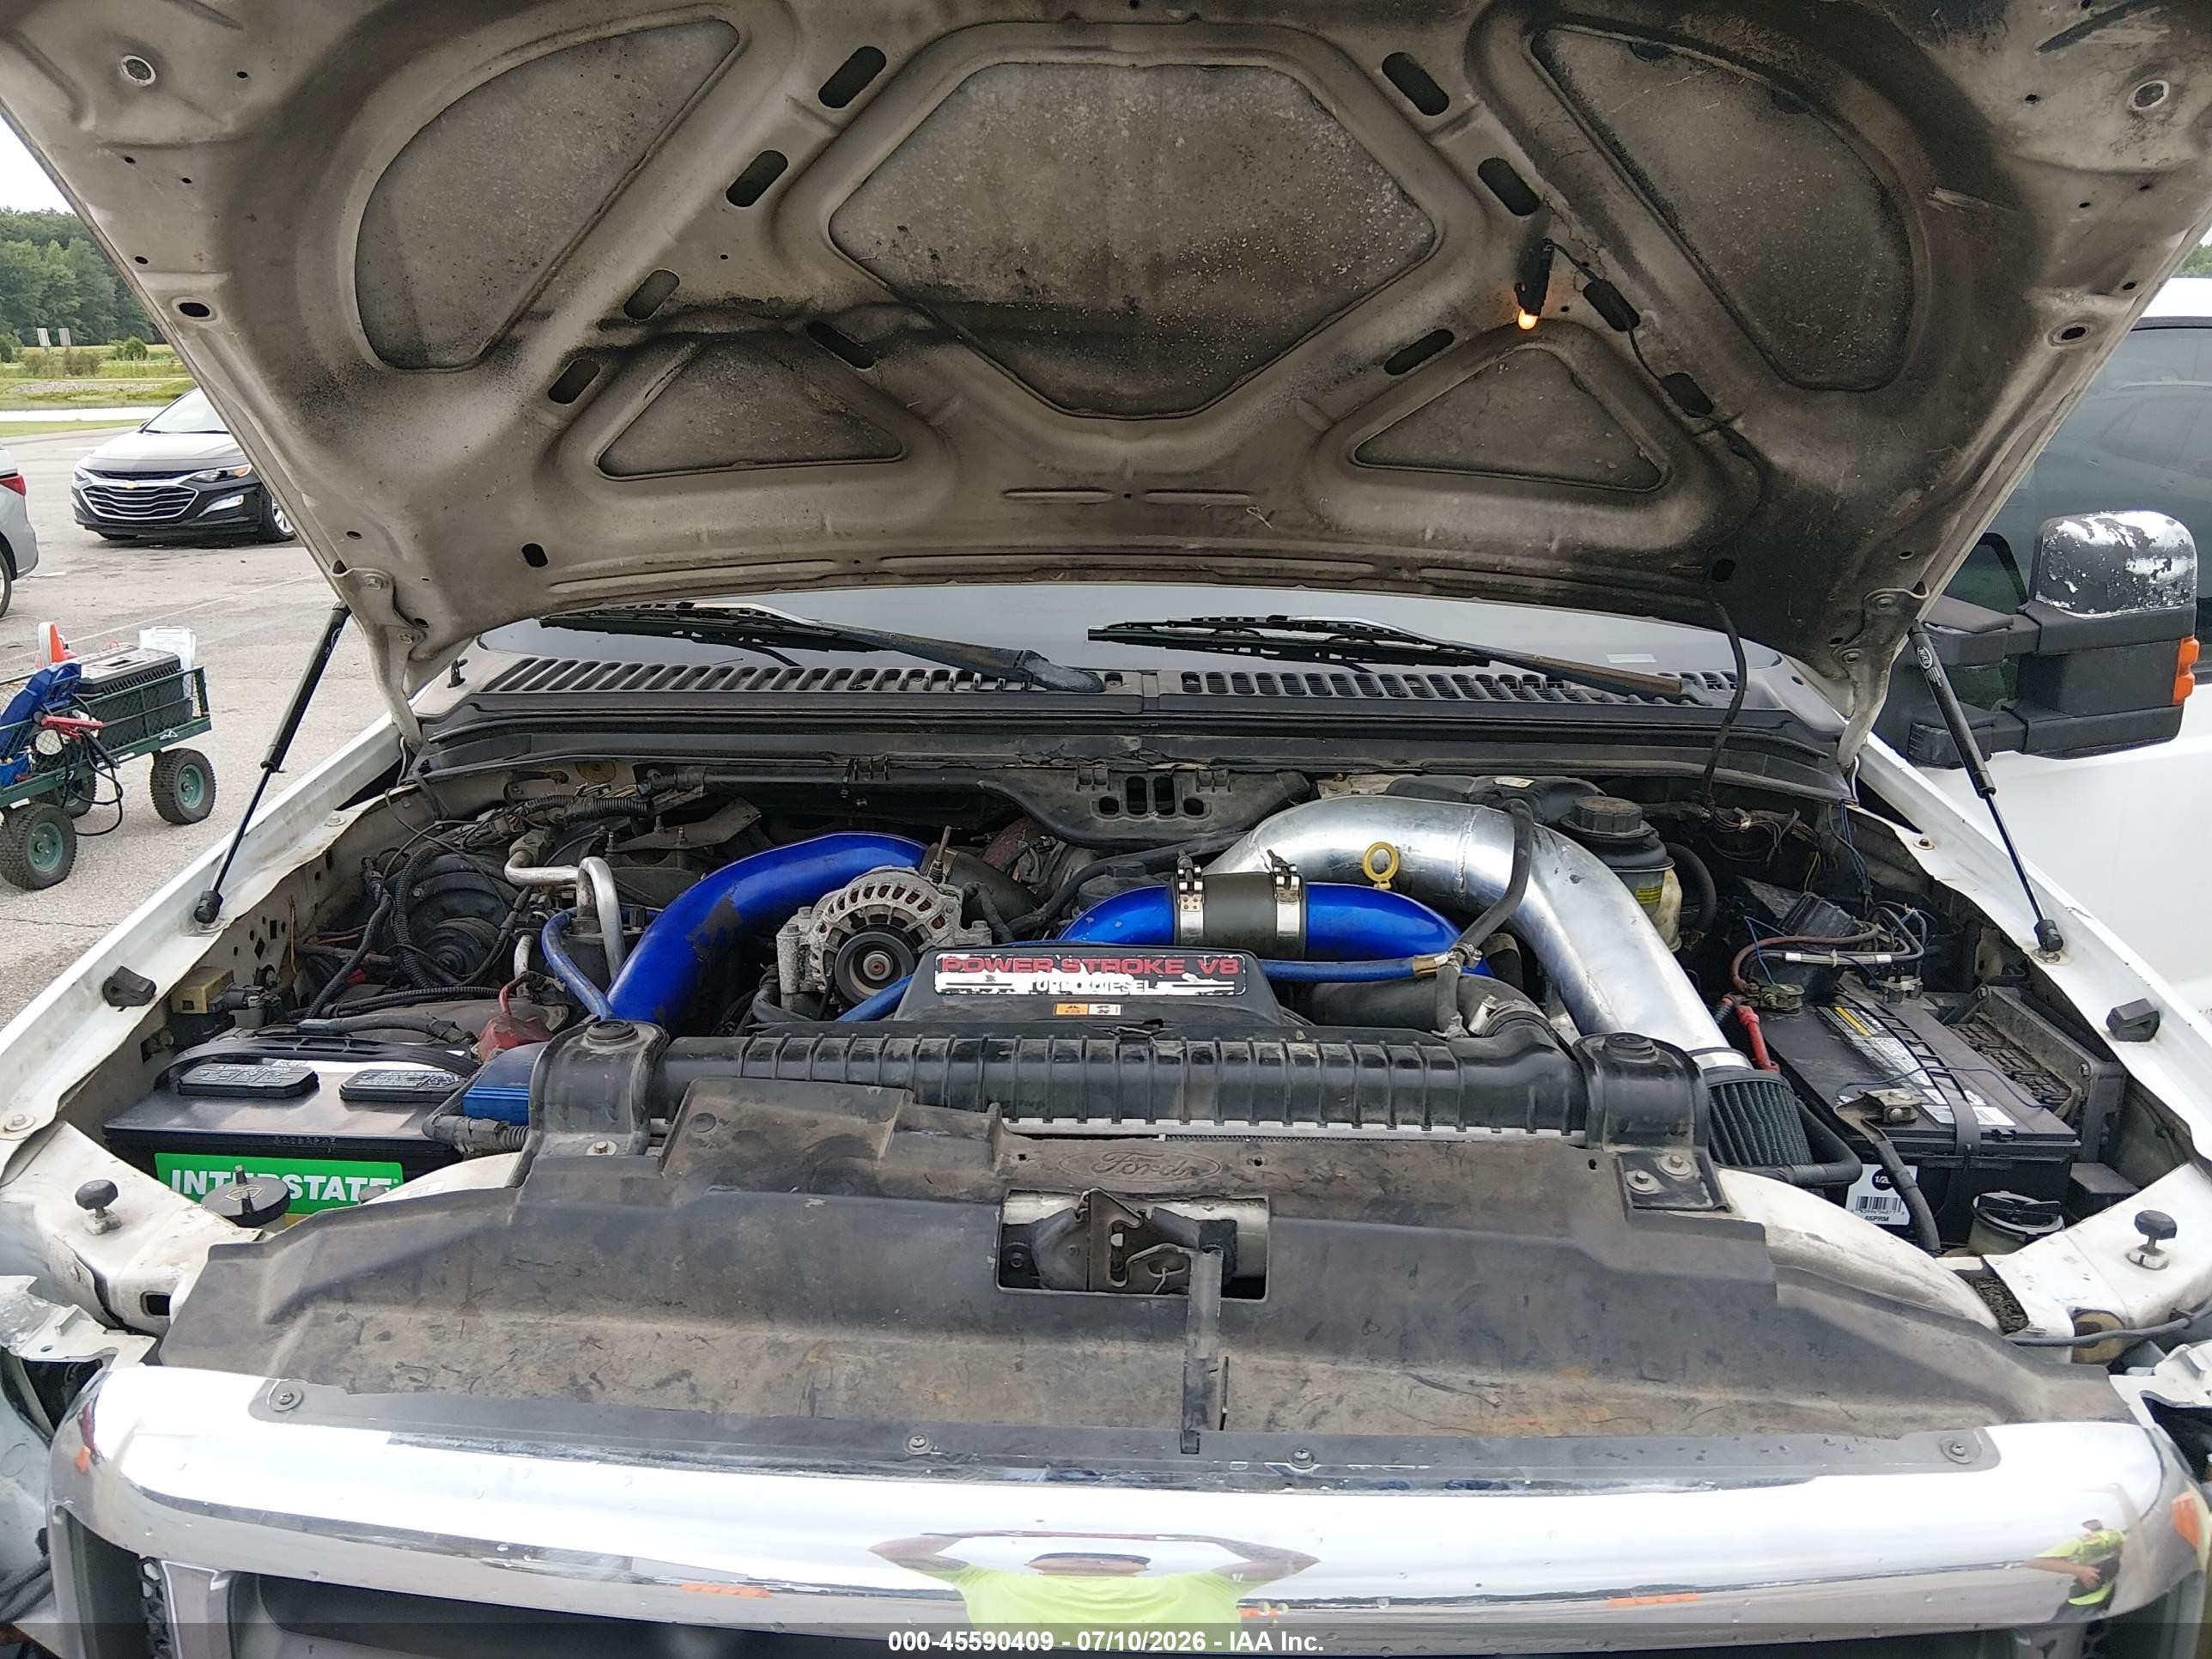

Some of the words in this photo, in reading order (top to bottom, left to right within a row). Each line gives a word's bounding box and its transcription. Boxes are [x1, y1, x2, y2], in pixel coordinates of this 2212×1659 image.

[942, 957, 1054, 974] POWER
[1060, 958, 1186, 975] STROKE
[1197, 958, 1239, 975] V8
[1091, 1152, 1200, 1176] Ford
[171, 1169, 392, 1202] INTSTAT
